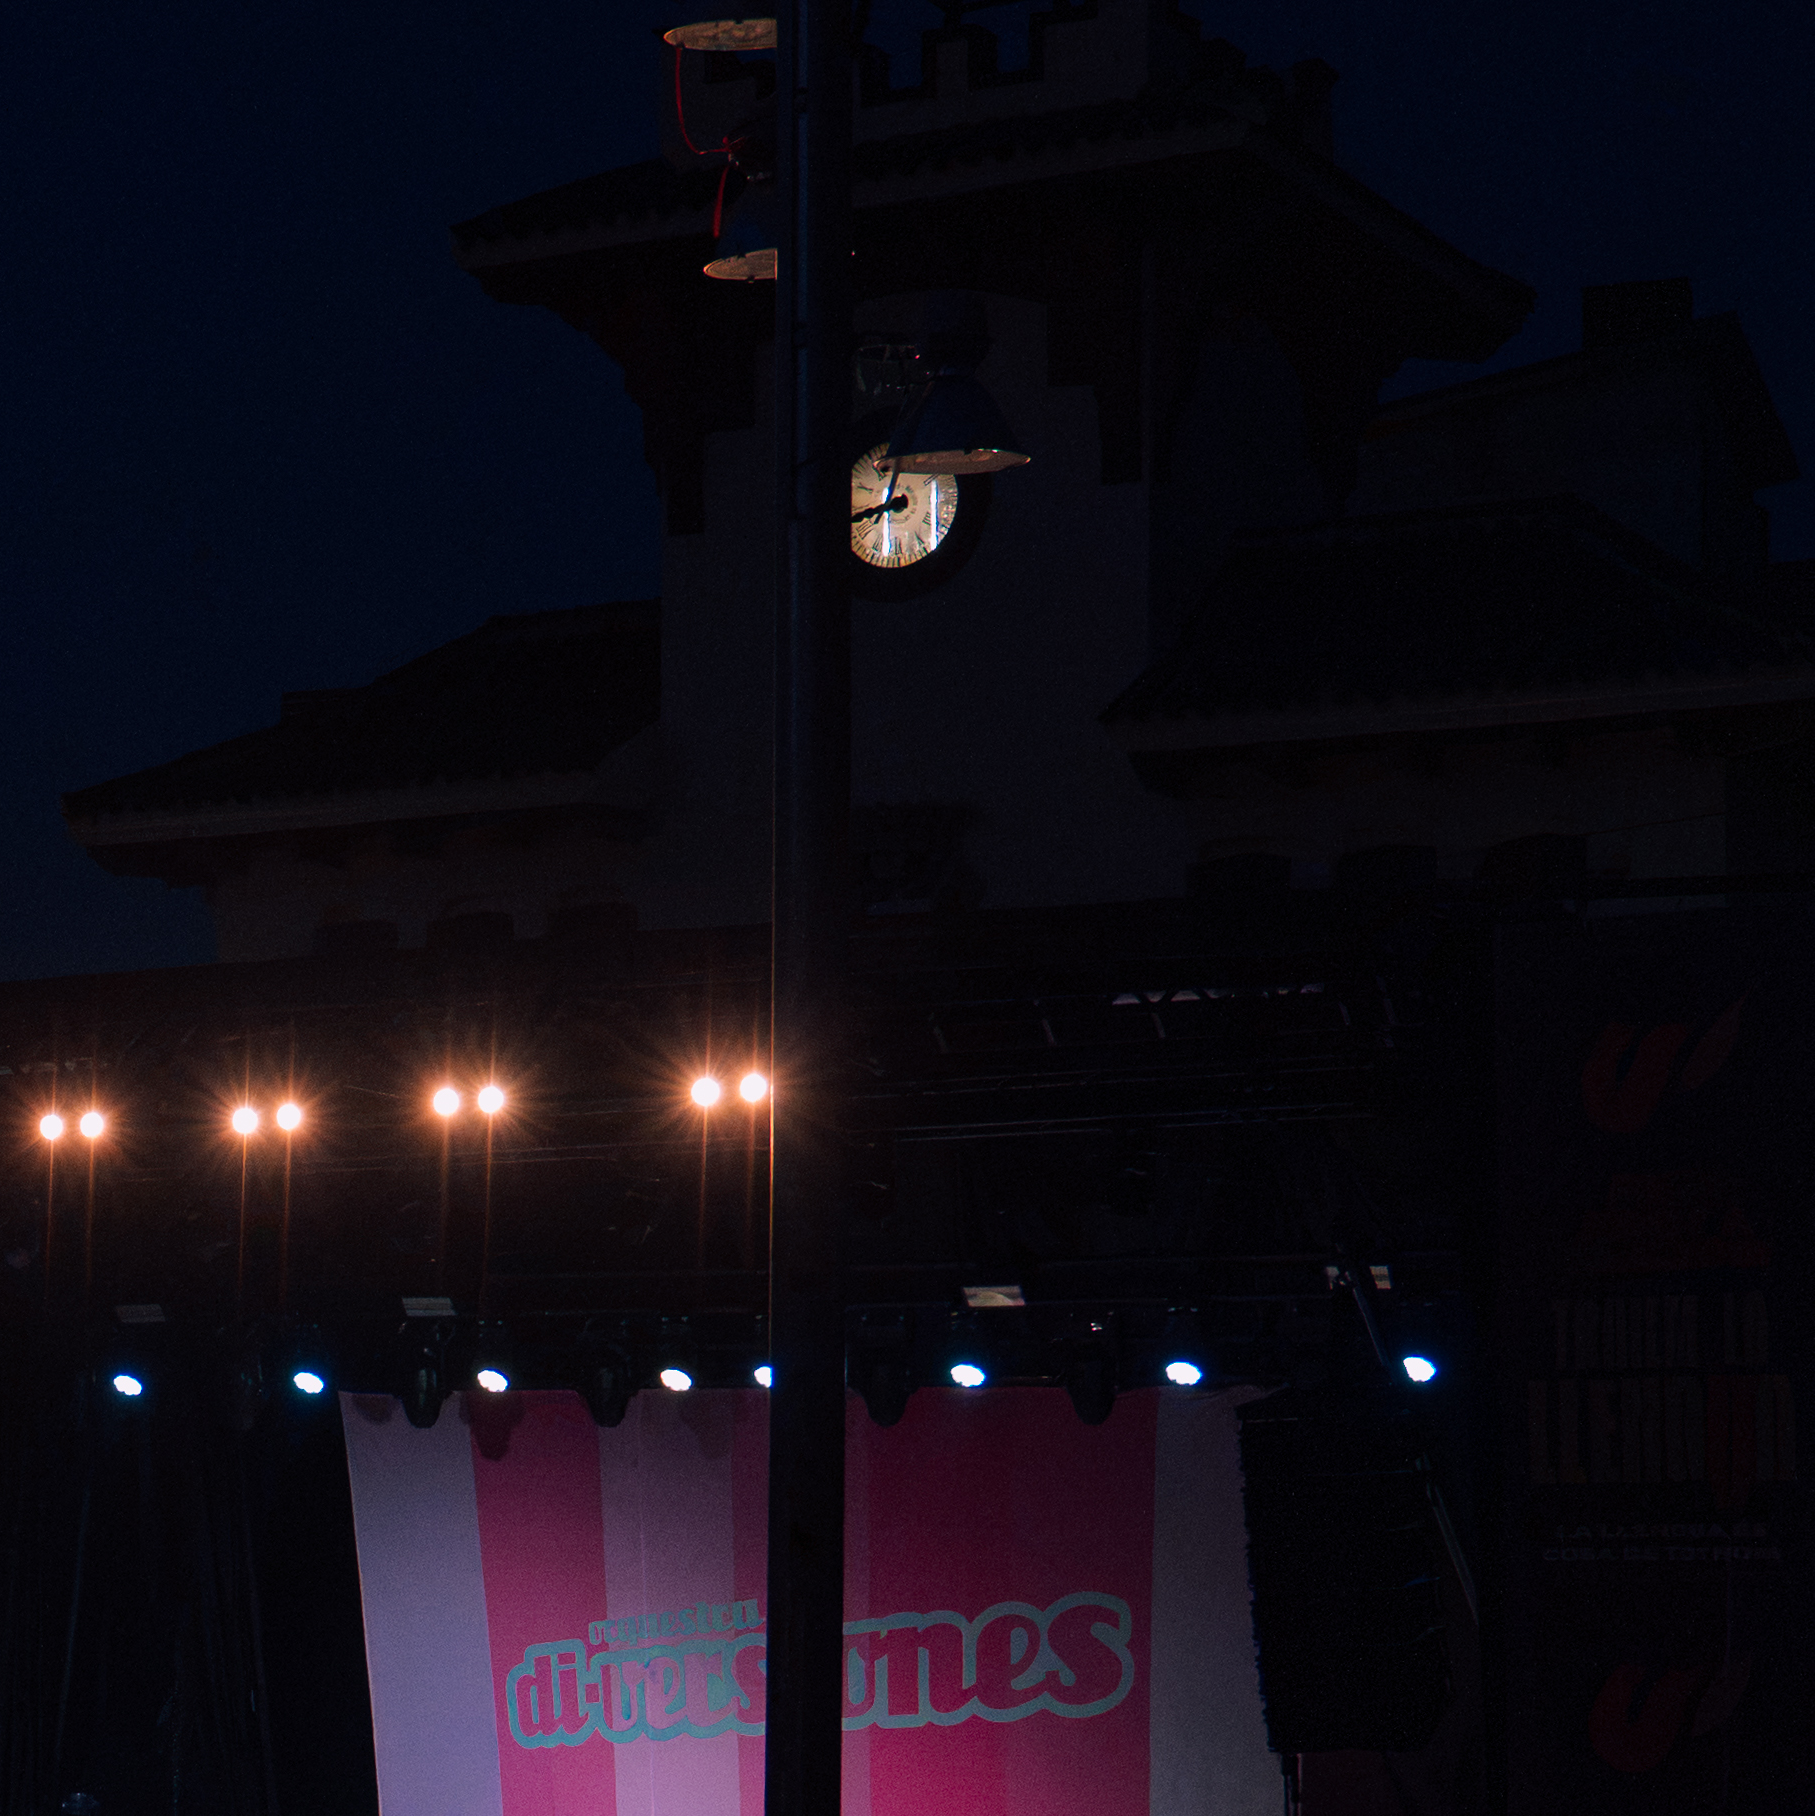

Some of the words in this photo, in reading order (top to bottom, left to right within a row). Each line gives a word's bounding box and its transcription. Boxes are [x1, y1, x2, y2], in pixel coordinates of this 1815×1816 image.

[1723, 1291, 1769, 1366] LA
[588, 1599, 765, 1646] orquestra
[509, 1596, 1132, 1746] di-versones
